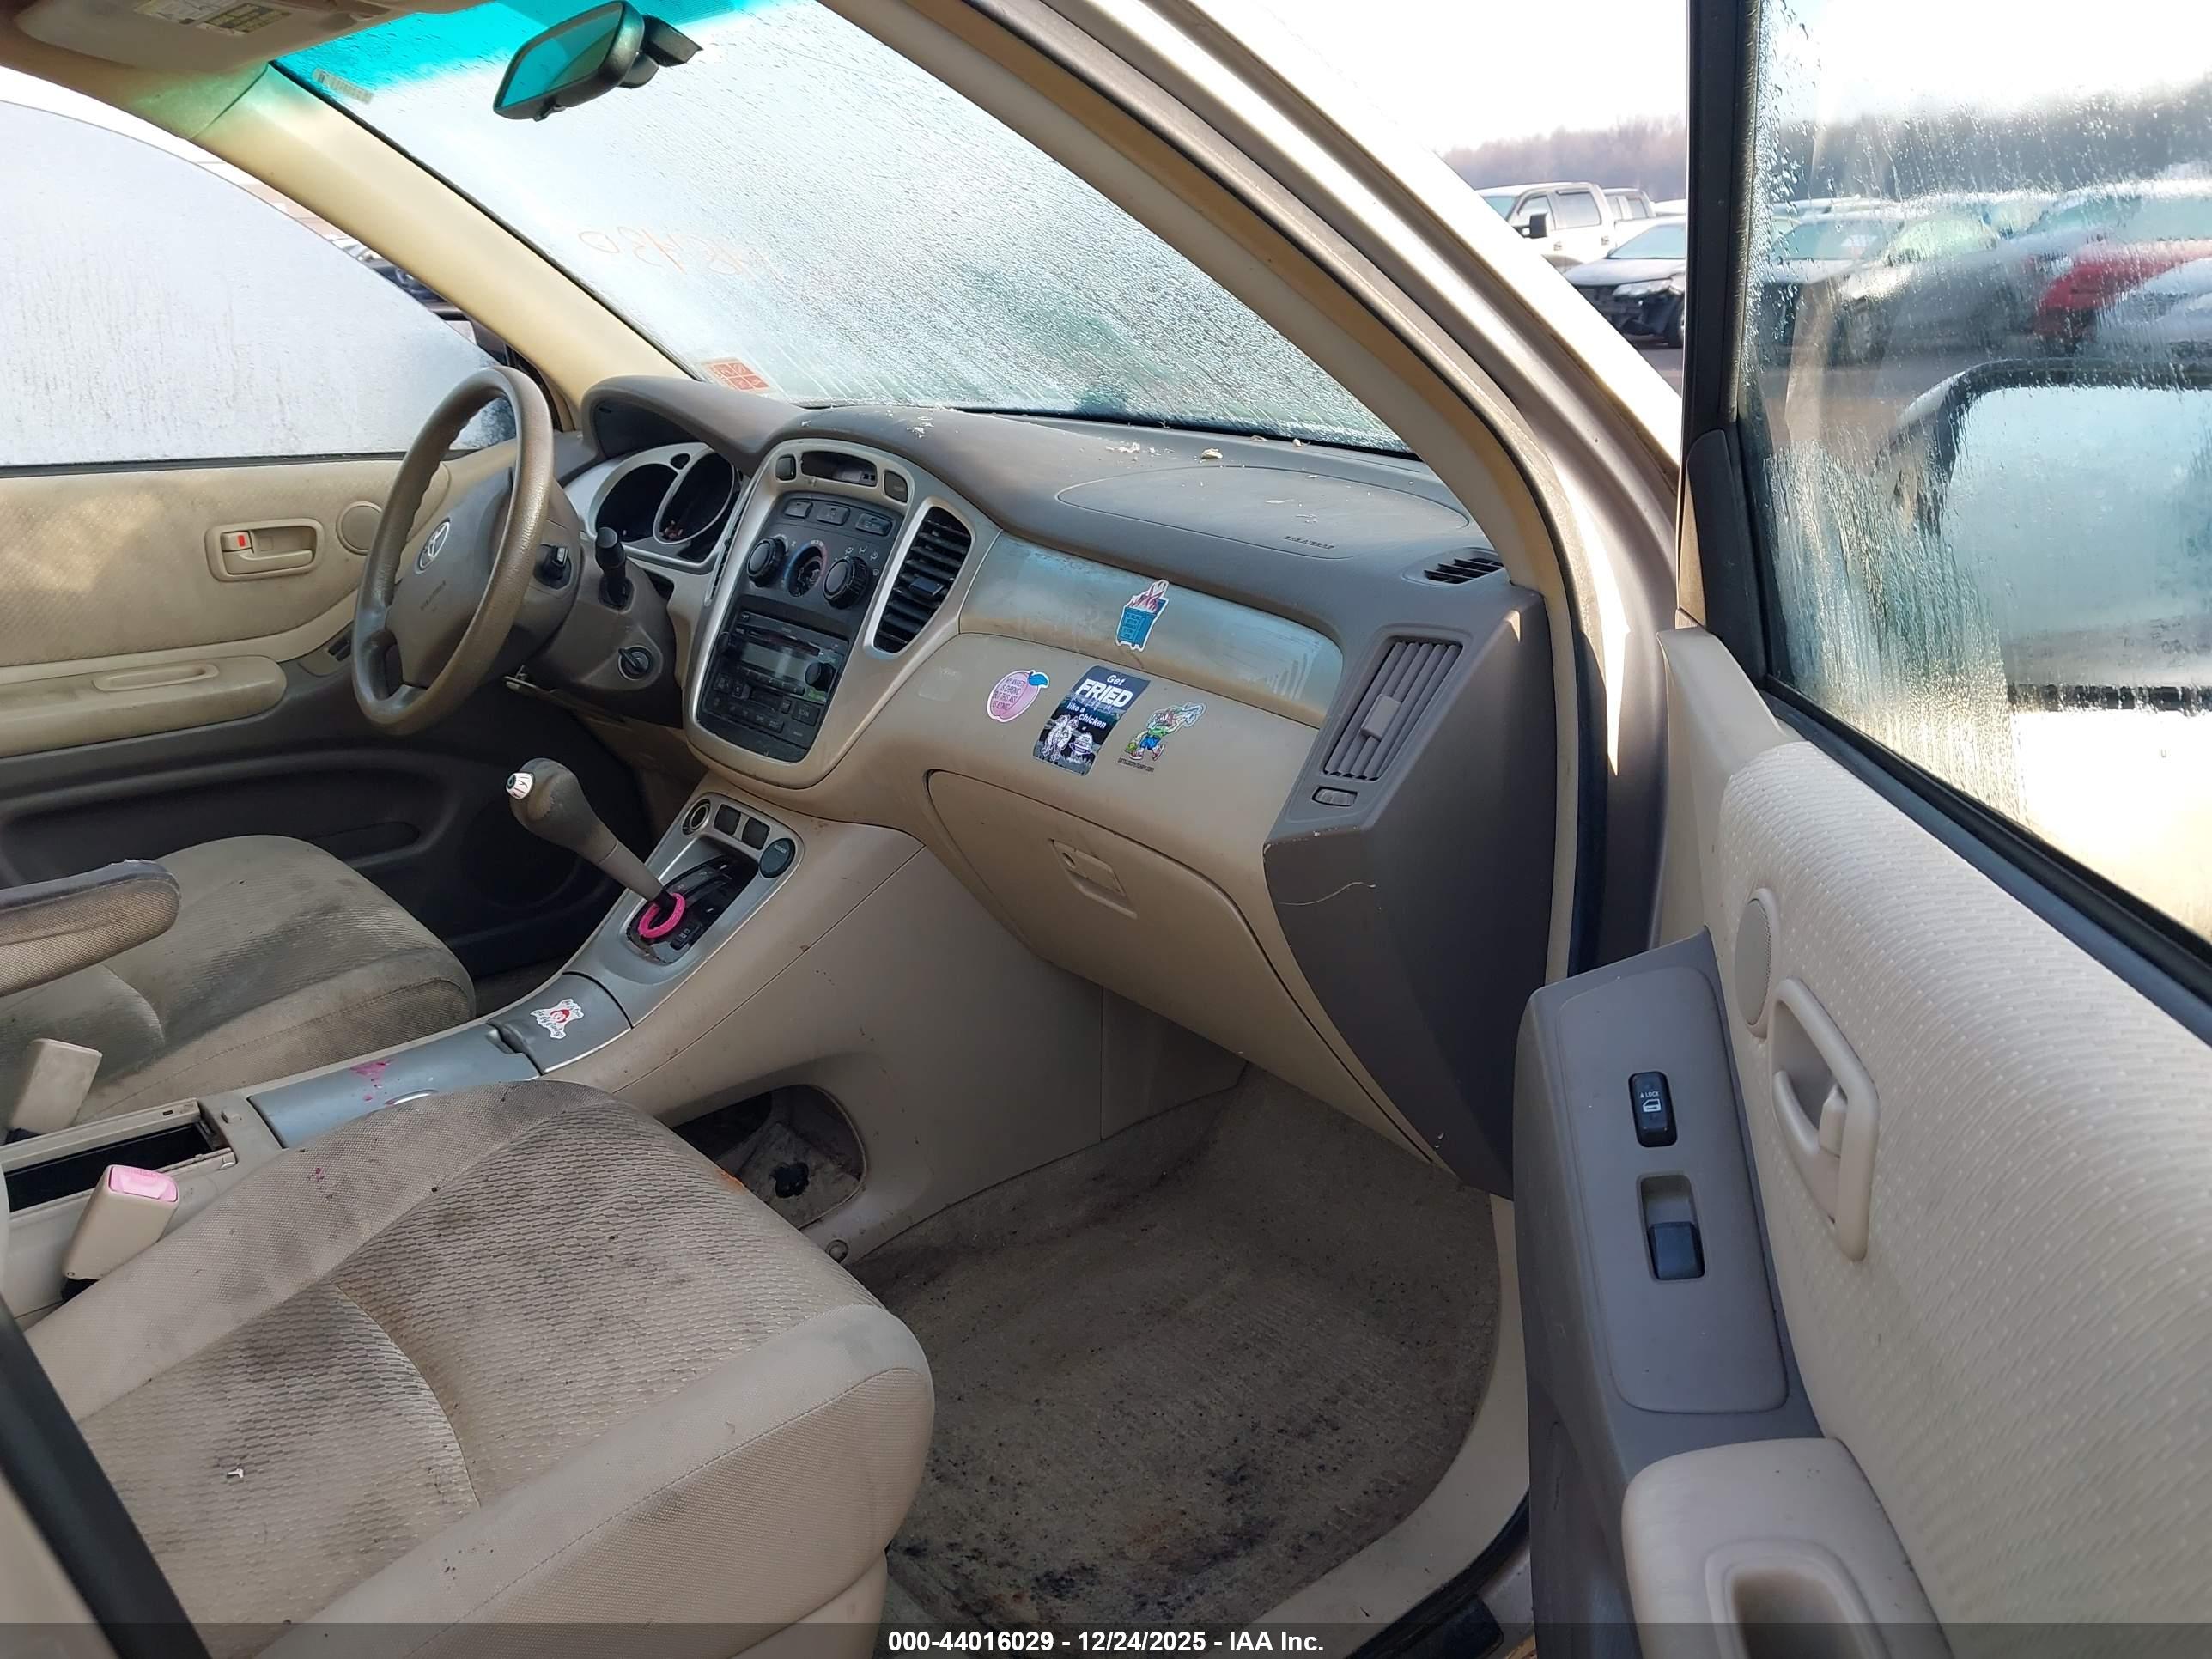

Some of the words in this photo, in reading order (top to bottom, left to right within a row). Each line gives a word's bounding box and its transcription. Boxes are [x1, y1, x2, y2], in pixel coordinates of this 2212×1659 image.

[1107, 674, 1126, 685] Get
[1075, 678, 1133, 707] FRIED
[1066, 702, 1079, 711] like
[1079, 714, 1107, 729] chicken
